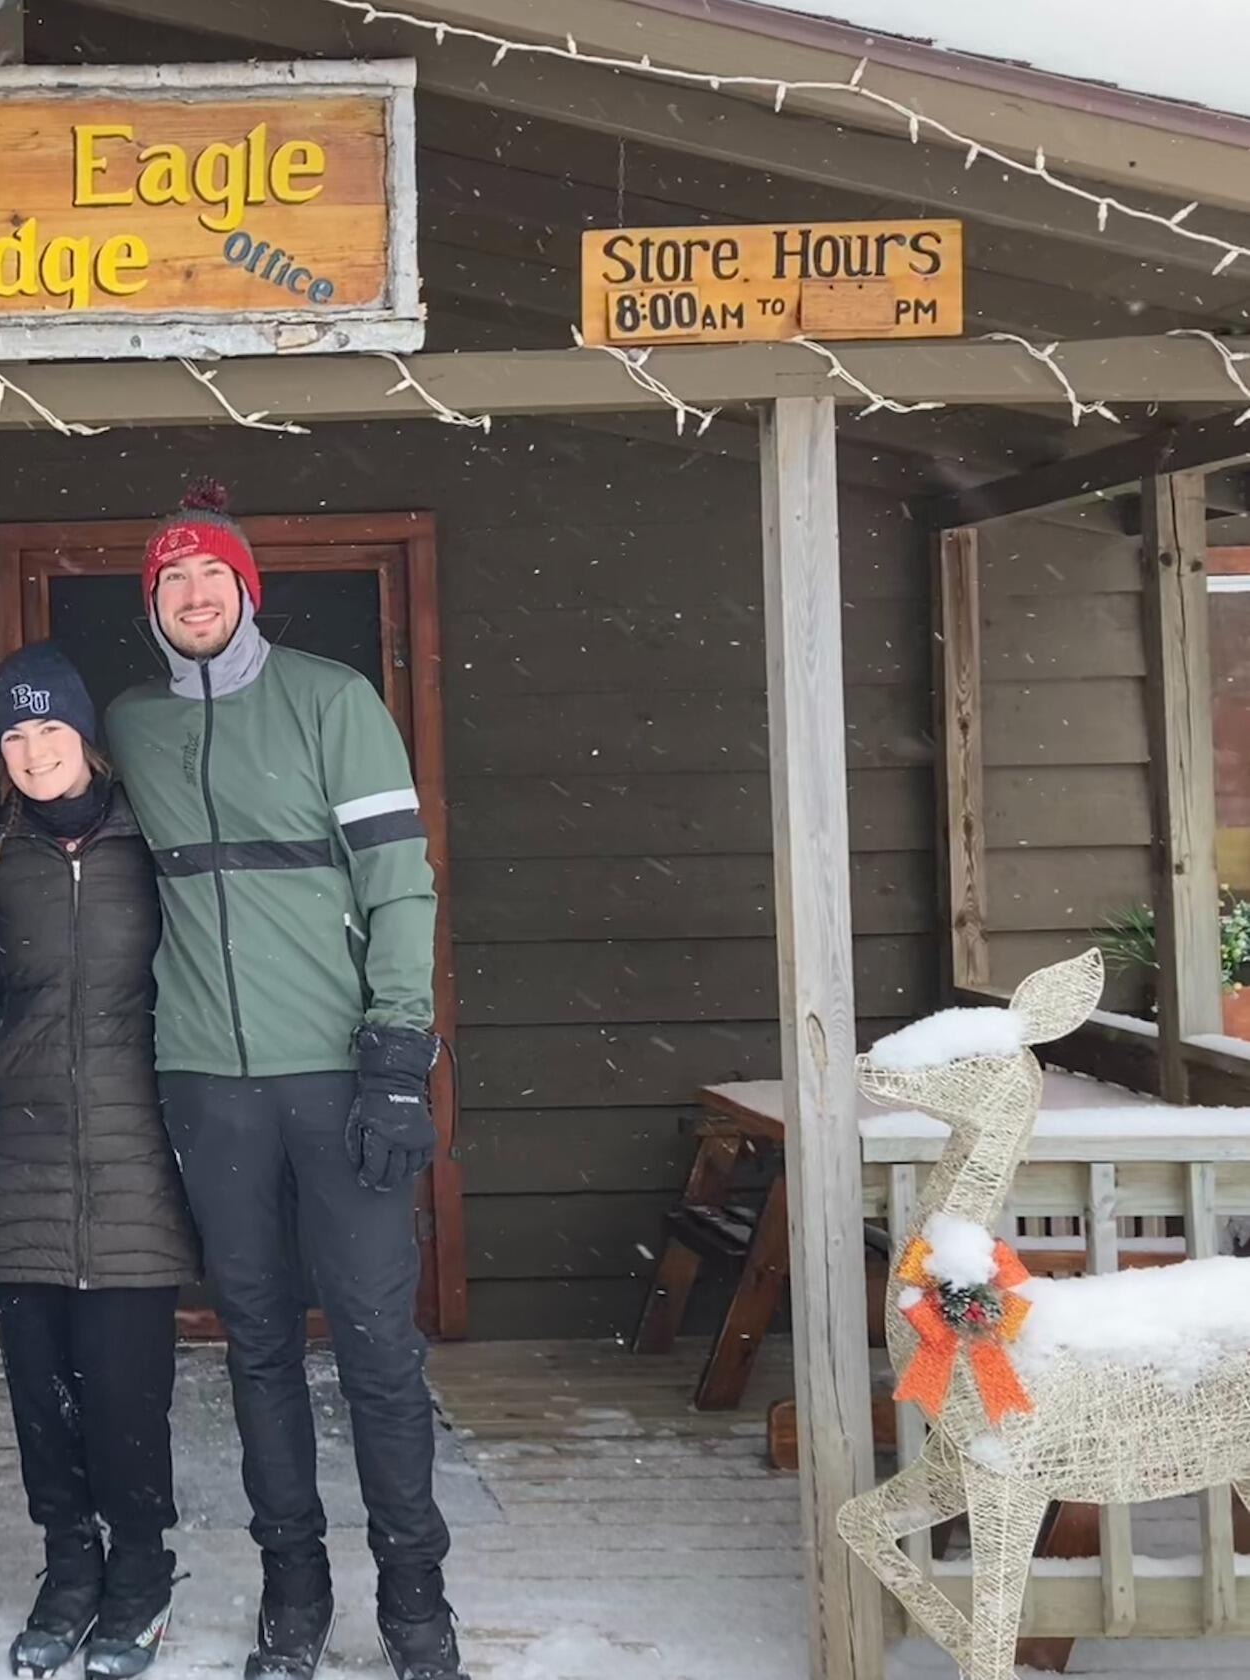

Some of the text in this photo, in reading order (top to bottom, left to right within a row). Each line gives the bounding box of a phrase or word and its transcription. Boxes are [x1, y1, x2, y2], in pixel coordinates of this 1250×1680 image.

[72, 121, 327, 231] Eagle
[221, 230, 335, 305] Office
[602, 228, 943, 284] Store Hours
[701, 302, 745, 331] AM
[757, 298, 786, 316] TO
[895, 298, 938, 325] PM
[10, 683, 51, 715] BU
